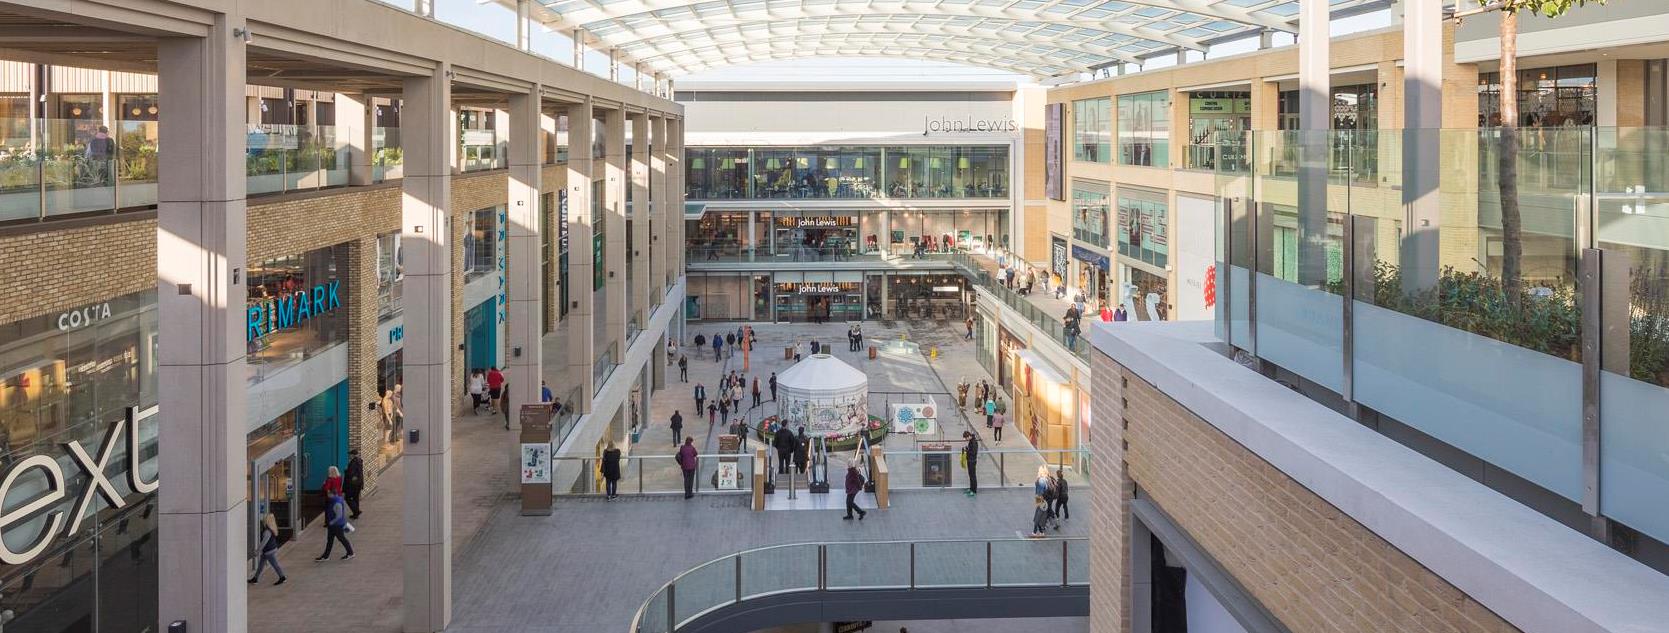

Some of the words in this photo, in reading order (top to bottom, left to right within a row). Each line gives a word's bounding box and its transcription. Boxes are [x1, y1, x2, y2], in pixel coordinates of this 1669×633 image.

[923, 112, 963, 136] John
[968, 112, 1016, 132] Lewis
[798, 218, 815, 229] John
[815, 218, 837, 227] Lewis
[798, 284, 817, 295] John
[817, 284, 839, 293] Lewis
[58, 302, 112, 331] COSTA
[247, 279, 341, 343] RIMARK
[0, 404, 159, 566] ext
